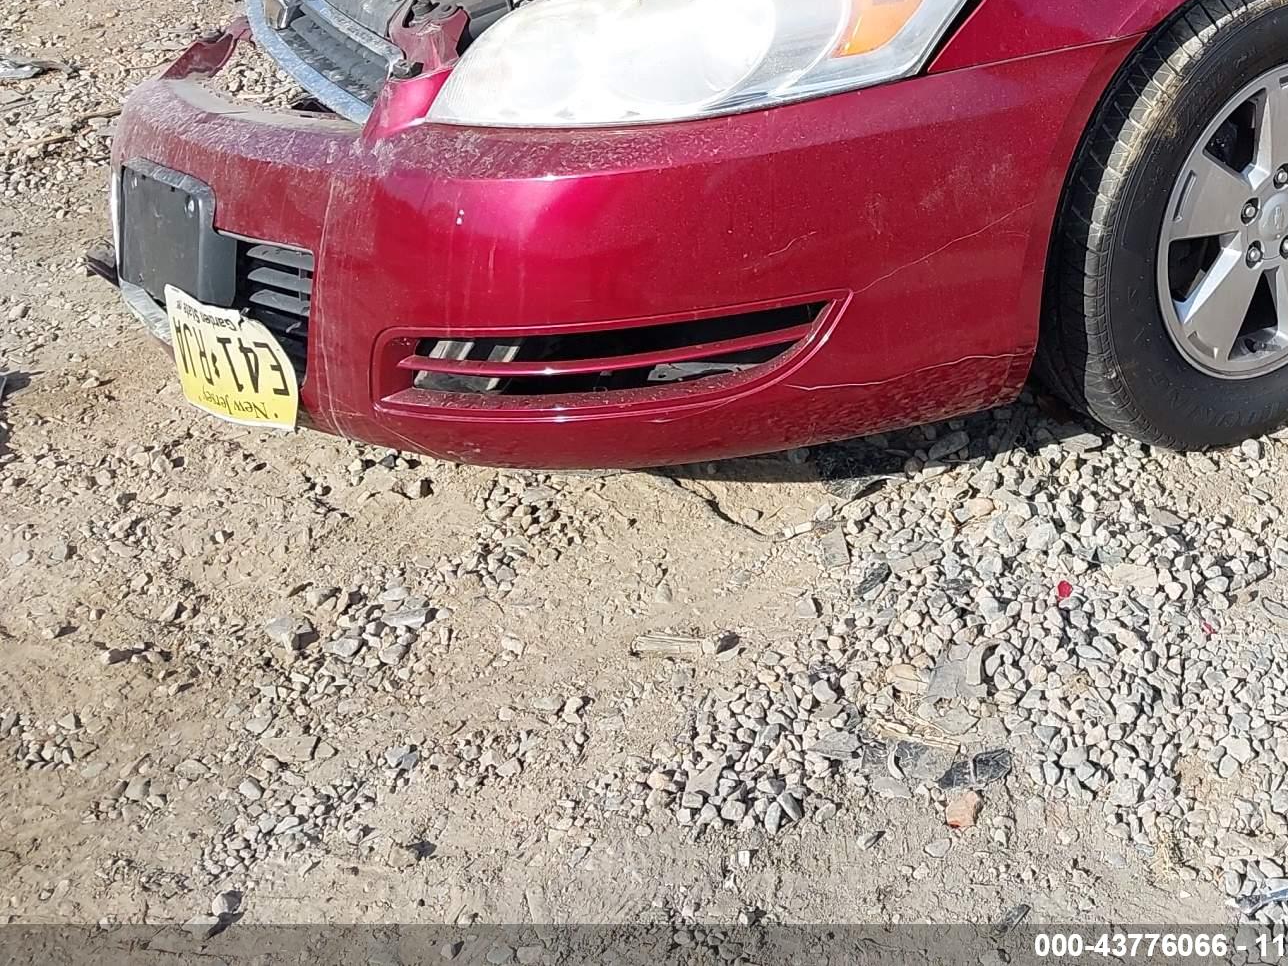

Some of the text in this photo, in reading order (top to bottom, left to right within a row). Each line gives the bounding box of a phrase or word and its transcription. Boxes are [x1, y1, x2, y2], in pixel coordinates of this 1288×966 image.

[201, 314, 237, 332] Garden
[202, 384, 271, 420] New Jersey
